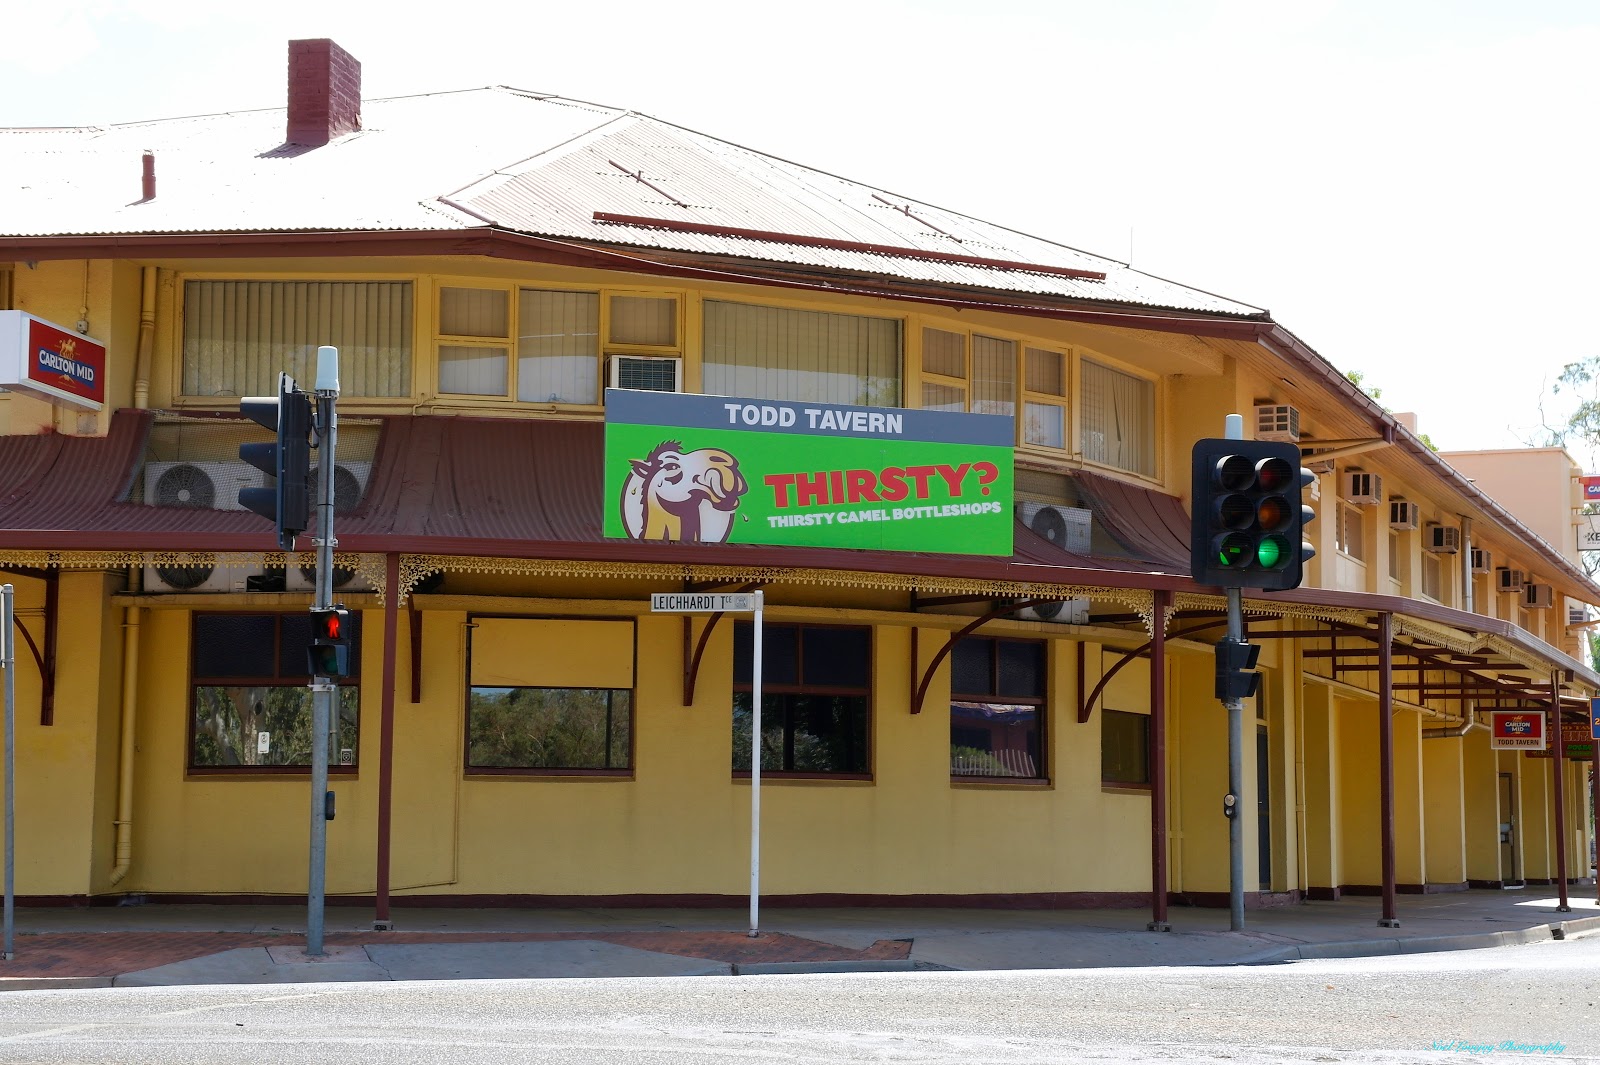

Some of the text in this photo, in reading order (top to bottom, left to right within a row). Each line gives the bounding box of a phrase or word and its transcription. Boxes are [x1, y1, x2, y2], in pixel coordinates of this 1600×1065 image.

[39, 350, 94, 381] CARLTON MID
[724, 403, 904, 434] TODD TAVERN
[764, 462, 1000, 508] THIRSTY?
[767, 501, 1002, 528] THIRSTY CAMEL BOTTLESHOPS
[653, 595, 716, 610] LEICHHARDT
